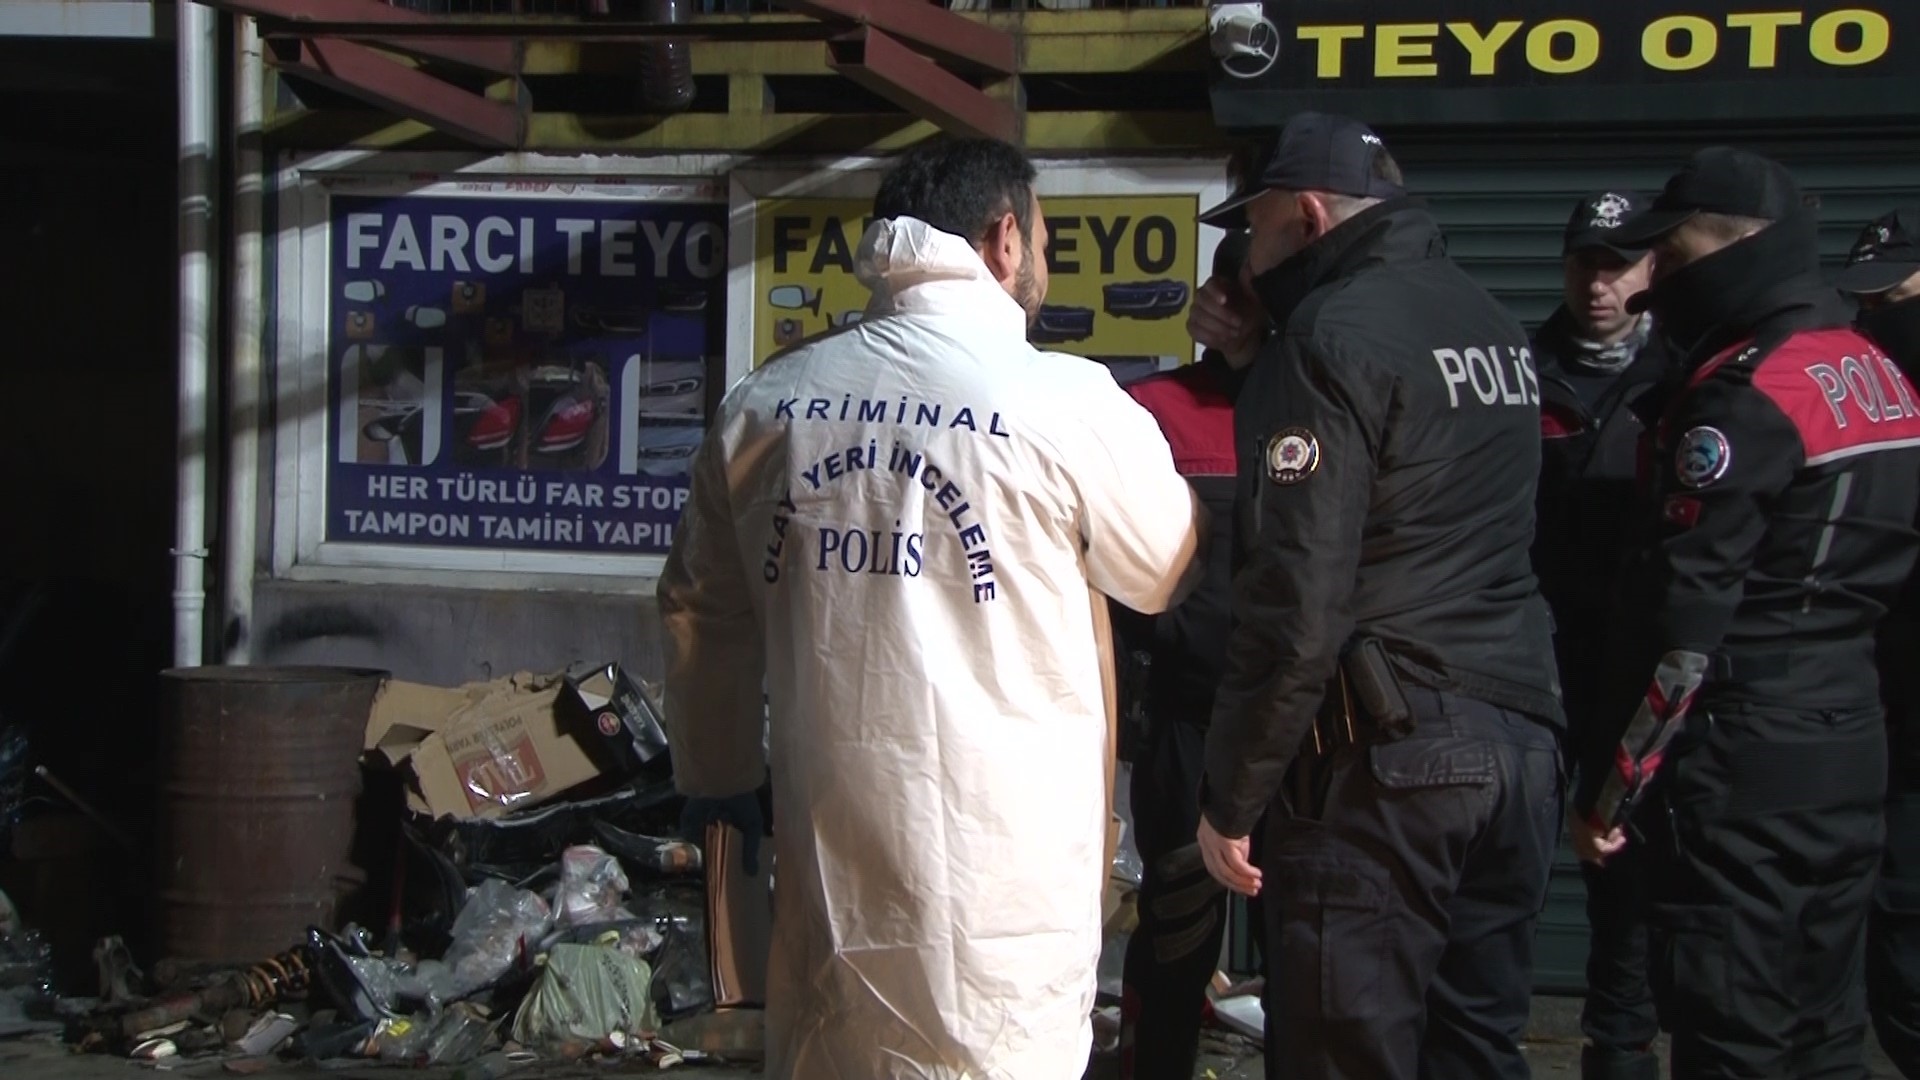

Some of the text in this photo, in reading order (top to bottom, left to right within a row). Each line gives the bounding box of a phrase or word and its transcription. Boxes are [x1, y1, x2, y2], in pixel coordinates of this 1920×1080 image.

[1297, 9, 1889, 78] TEYO OTO
[346, 213, 726, 279] FARCI TEYO
[1048, 216, 1177, 274] EYO
[368, 472, 690, 511] HER TÜRLÜ FAR STOP
[344, 510, 470, 538] TAMPON
[592, 520, 673, 546] YAPIL
[763, 489, 797, 584] OLAY
